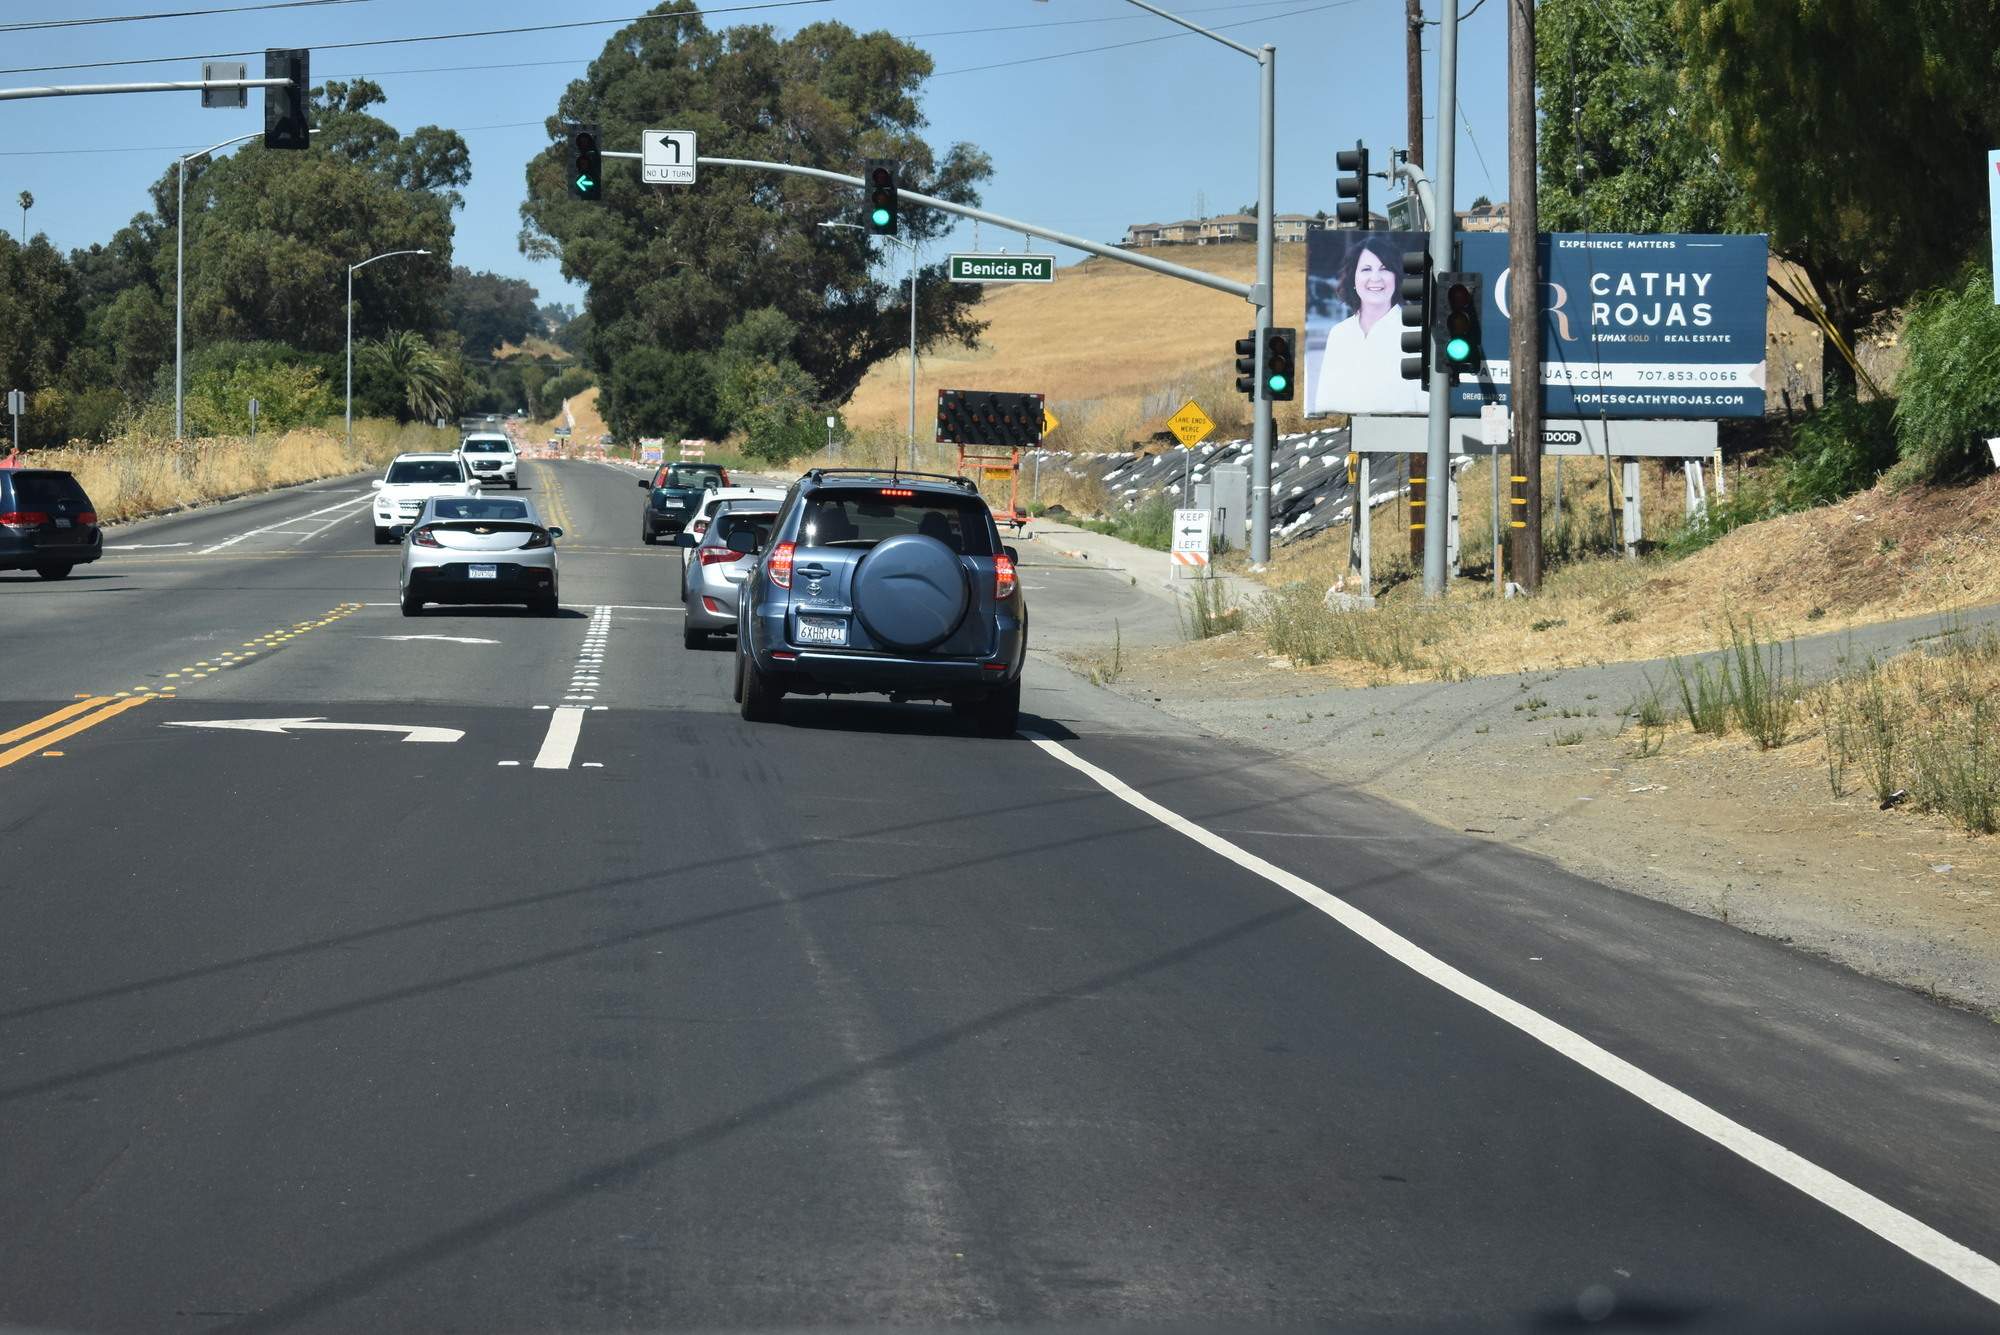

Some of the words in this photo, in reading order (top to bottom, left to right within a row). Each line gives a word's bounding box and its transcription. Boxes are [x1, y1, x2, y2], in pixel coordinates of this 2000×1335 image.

[661, 169, 668, 178] U
[1559, 240, 1623, 249] EXPERIENCE
[1628, 241, 1676, 249] MATTERS
[961, 261, 1017, 276] Benicia
[1022, 262, 1042, 276] Rd
[1590, 272, 1713, 297] CATHY
[1591, 302, 1713, 326] ROJAS
[1664, 335, 1689, 343] REAL
[1692, 335, 1731, 343] ESTATE
[1637, 370, 1738, 381] 707.853.0066
[1573, 393, 1744, 405] HOMES@CATHYROJAS.COM
[1541, 432, 1577, 442] TDOOR
[1180, 512, 1204, 521] KEEP
[1178, 541, 1201, 549] LEFT
[800, 626, 842, 641] 6XHR141
